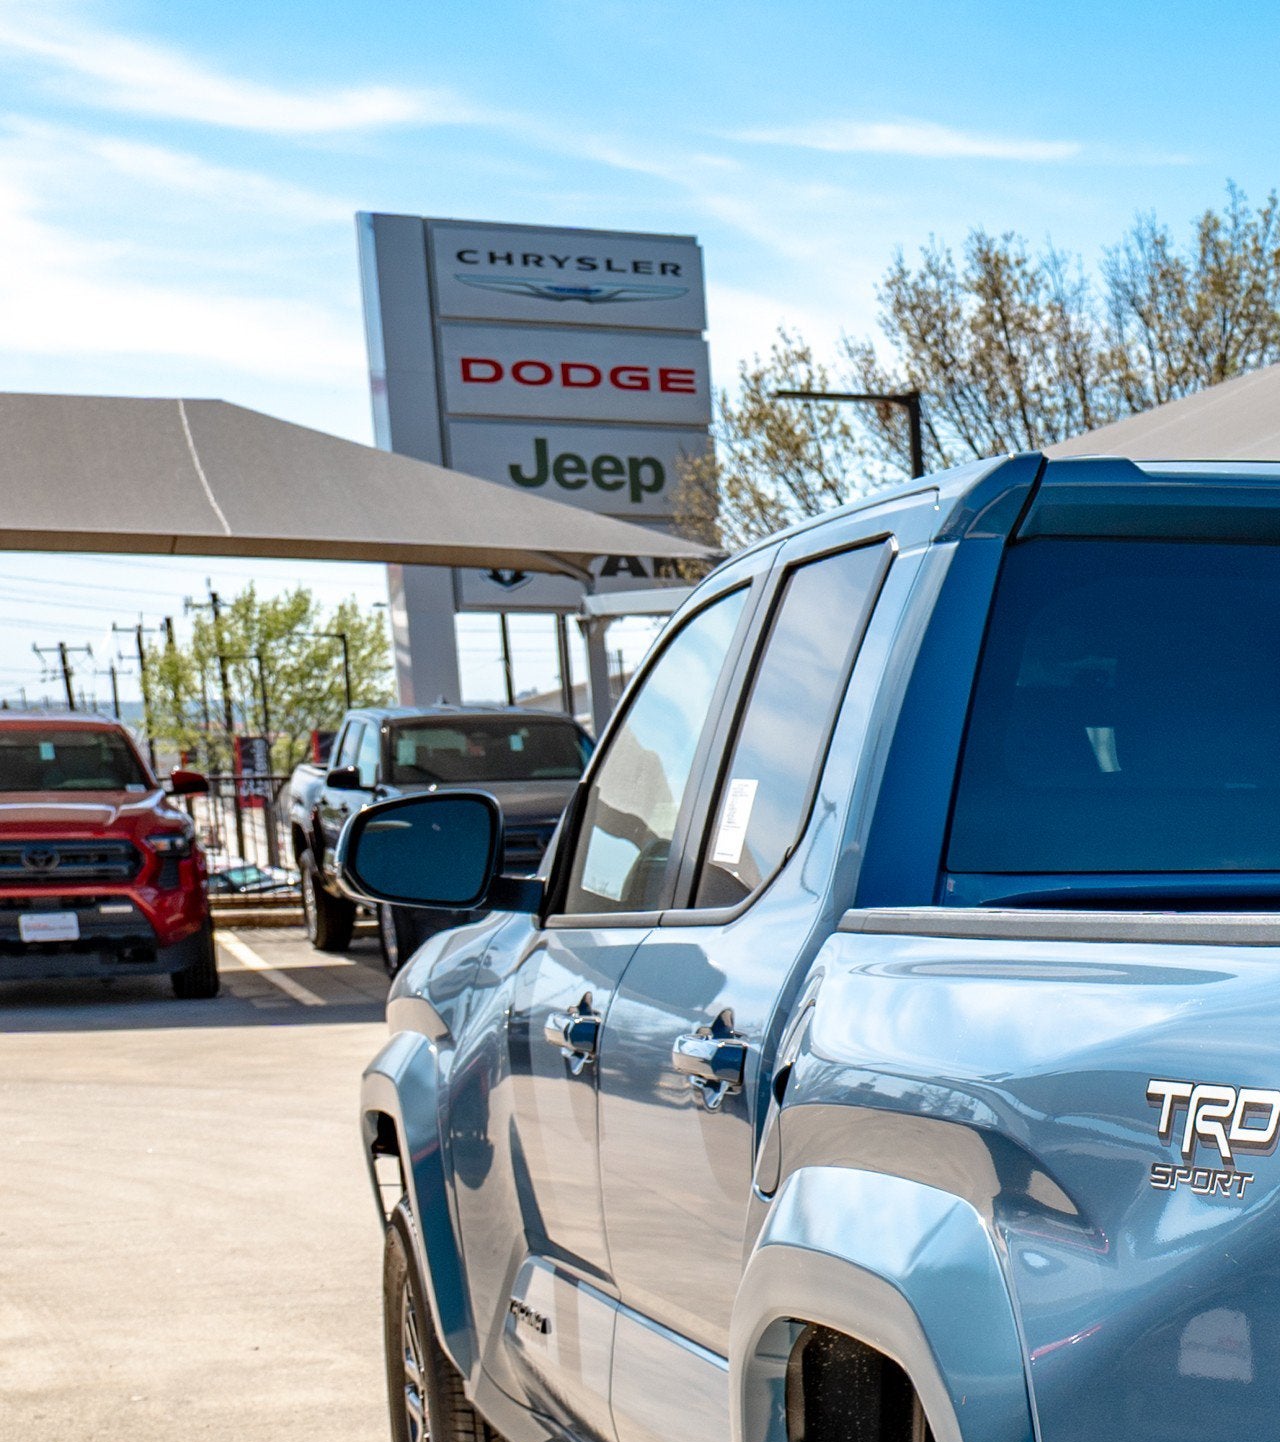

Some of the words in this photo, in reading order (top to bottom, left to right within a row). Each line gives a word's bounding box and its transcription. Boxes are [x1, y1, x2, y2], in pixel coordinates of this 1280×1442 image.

[455, 248, 683, 278] CHRYSLER
[459, 356, 697, 395] DODGE
[508, 436, 666, 503] Jeep
[1150, 1162, 1255, 1200] SPORT
